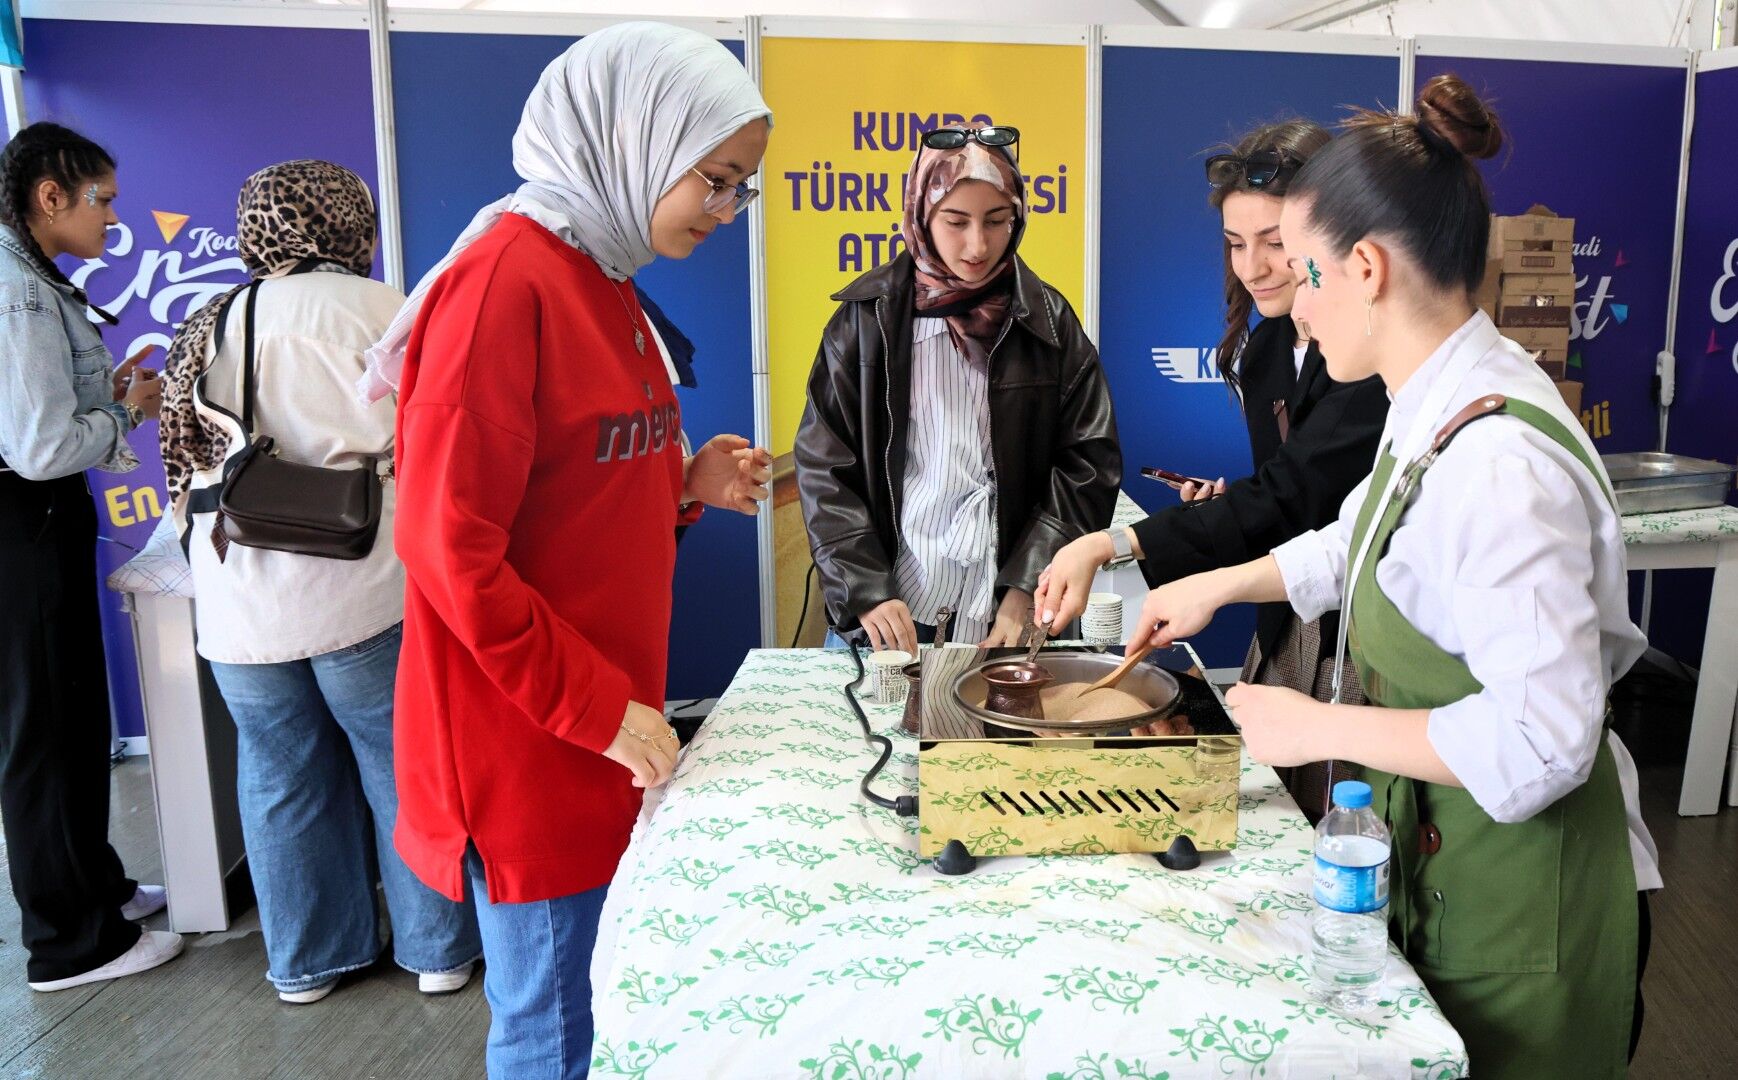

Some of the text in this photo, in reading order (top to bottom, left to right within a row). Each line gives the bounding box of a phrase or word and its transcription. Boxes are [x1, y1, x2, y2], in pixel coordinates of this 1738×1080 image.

[853, 111, 993, 151] KUM
[784, 161, 892, 212] TÜRK
[104, 485, 163, 527] En
